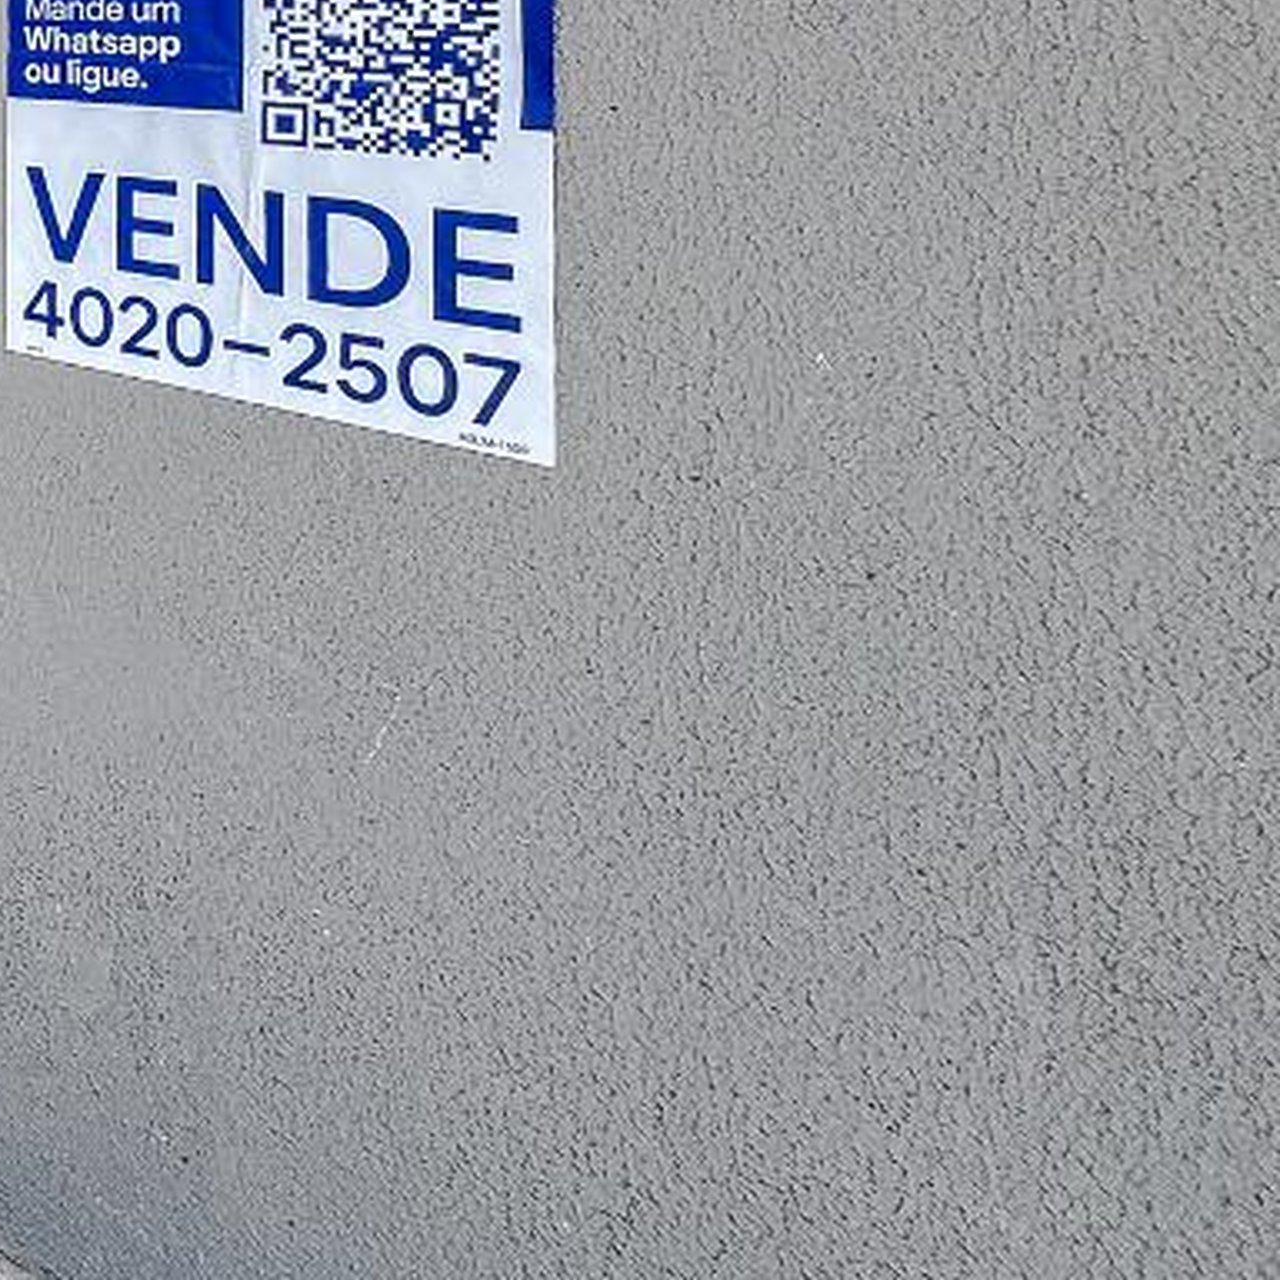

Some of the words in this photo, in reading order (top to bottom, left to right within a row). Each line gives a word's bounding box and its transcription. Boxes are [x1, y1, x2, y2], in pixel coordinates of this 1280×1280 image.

[131, 0, 181, 24] um
[23, 26, 181, 64] Whatsapp
[25, 62, 61, 85] ou
[66, 57, 148, 94] ligue.
[26, 166, 522, 334] VENDE
[23, 280, 522, 426] 4020-2507
